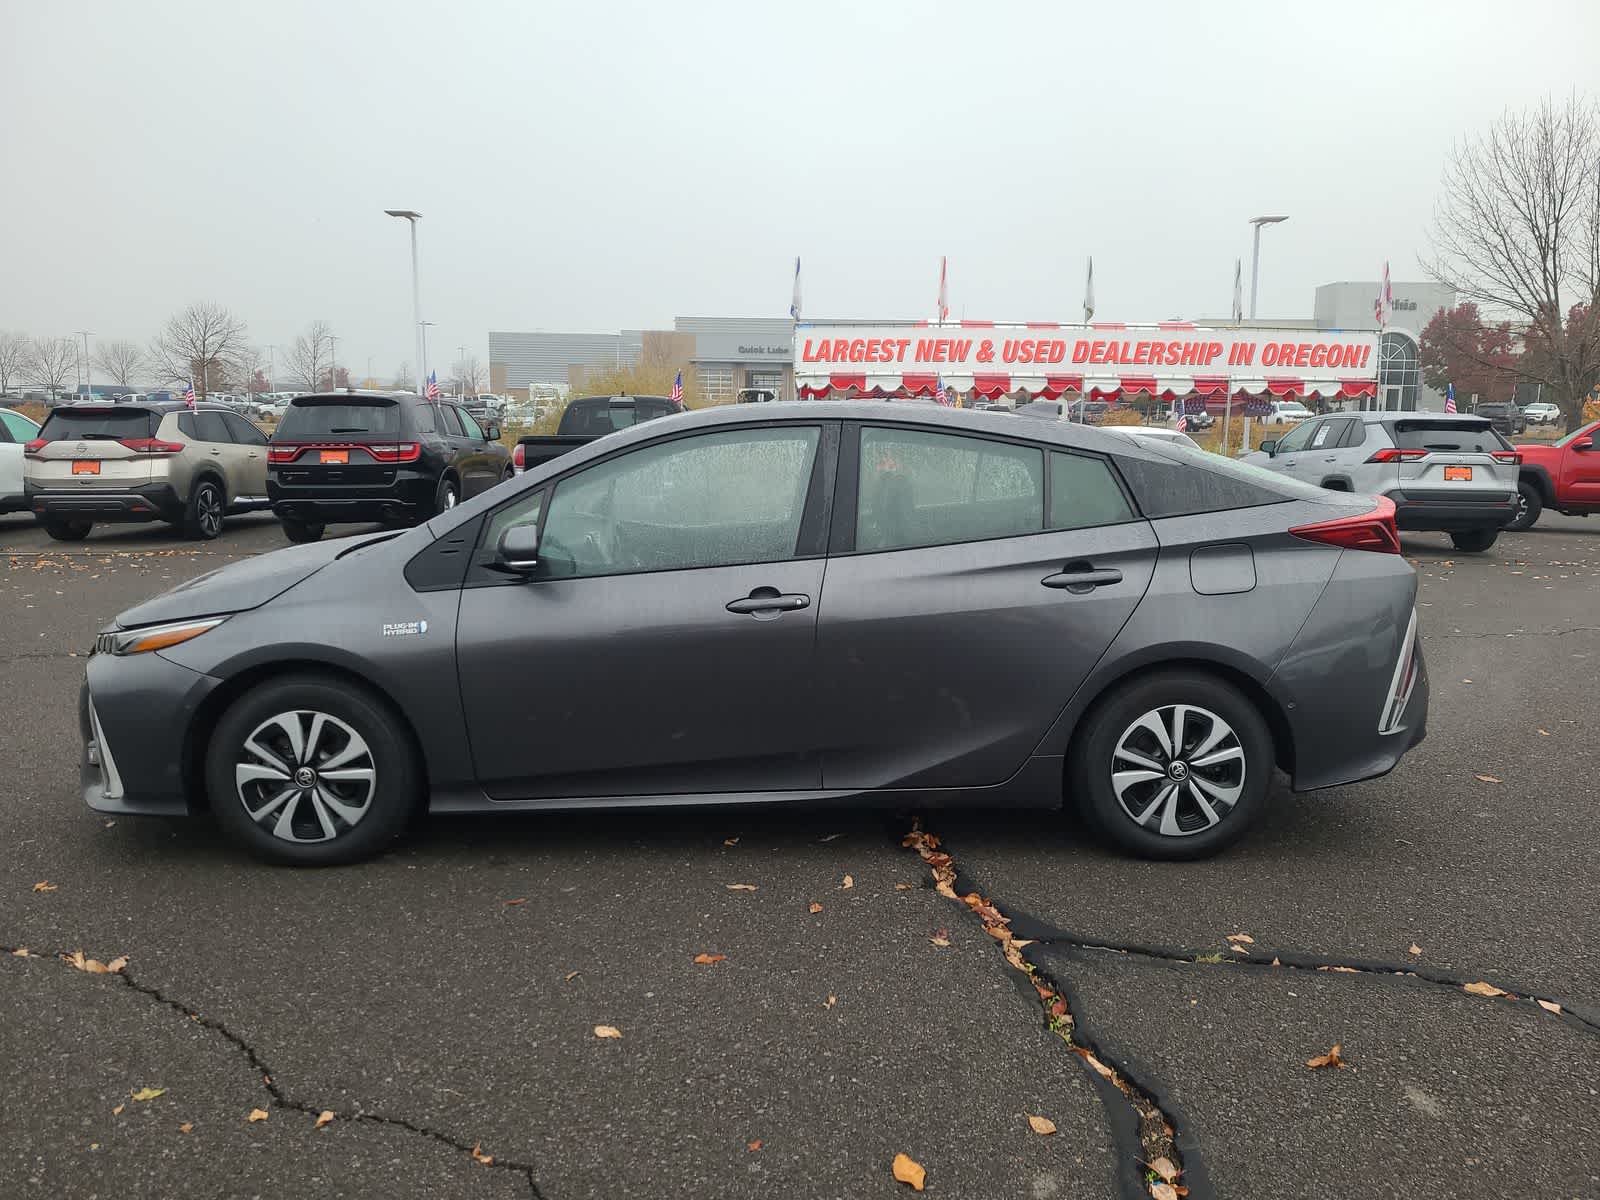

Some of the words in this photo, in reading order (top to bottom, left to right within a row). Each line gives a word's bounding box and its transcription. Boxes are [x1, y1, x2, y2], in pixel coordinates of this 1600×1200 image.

[738, 345, 766, 353] Quick
[767, 346, 789, 354] Lube
[802, 338, 911, 363] LARGEST
[914, 339, 972, 363] NEW
[975, 339, 995, 363] &
[1002, 339, 1066, 363] USED
[1071, 339, 1224, 366] DEALERSHIP
[1227, 342, 1257, 366] IN
[1261, 342, 1372, 368] OREGON!
